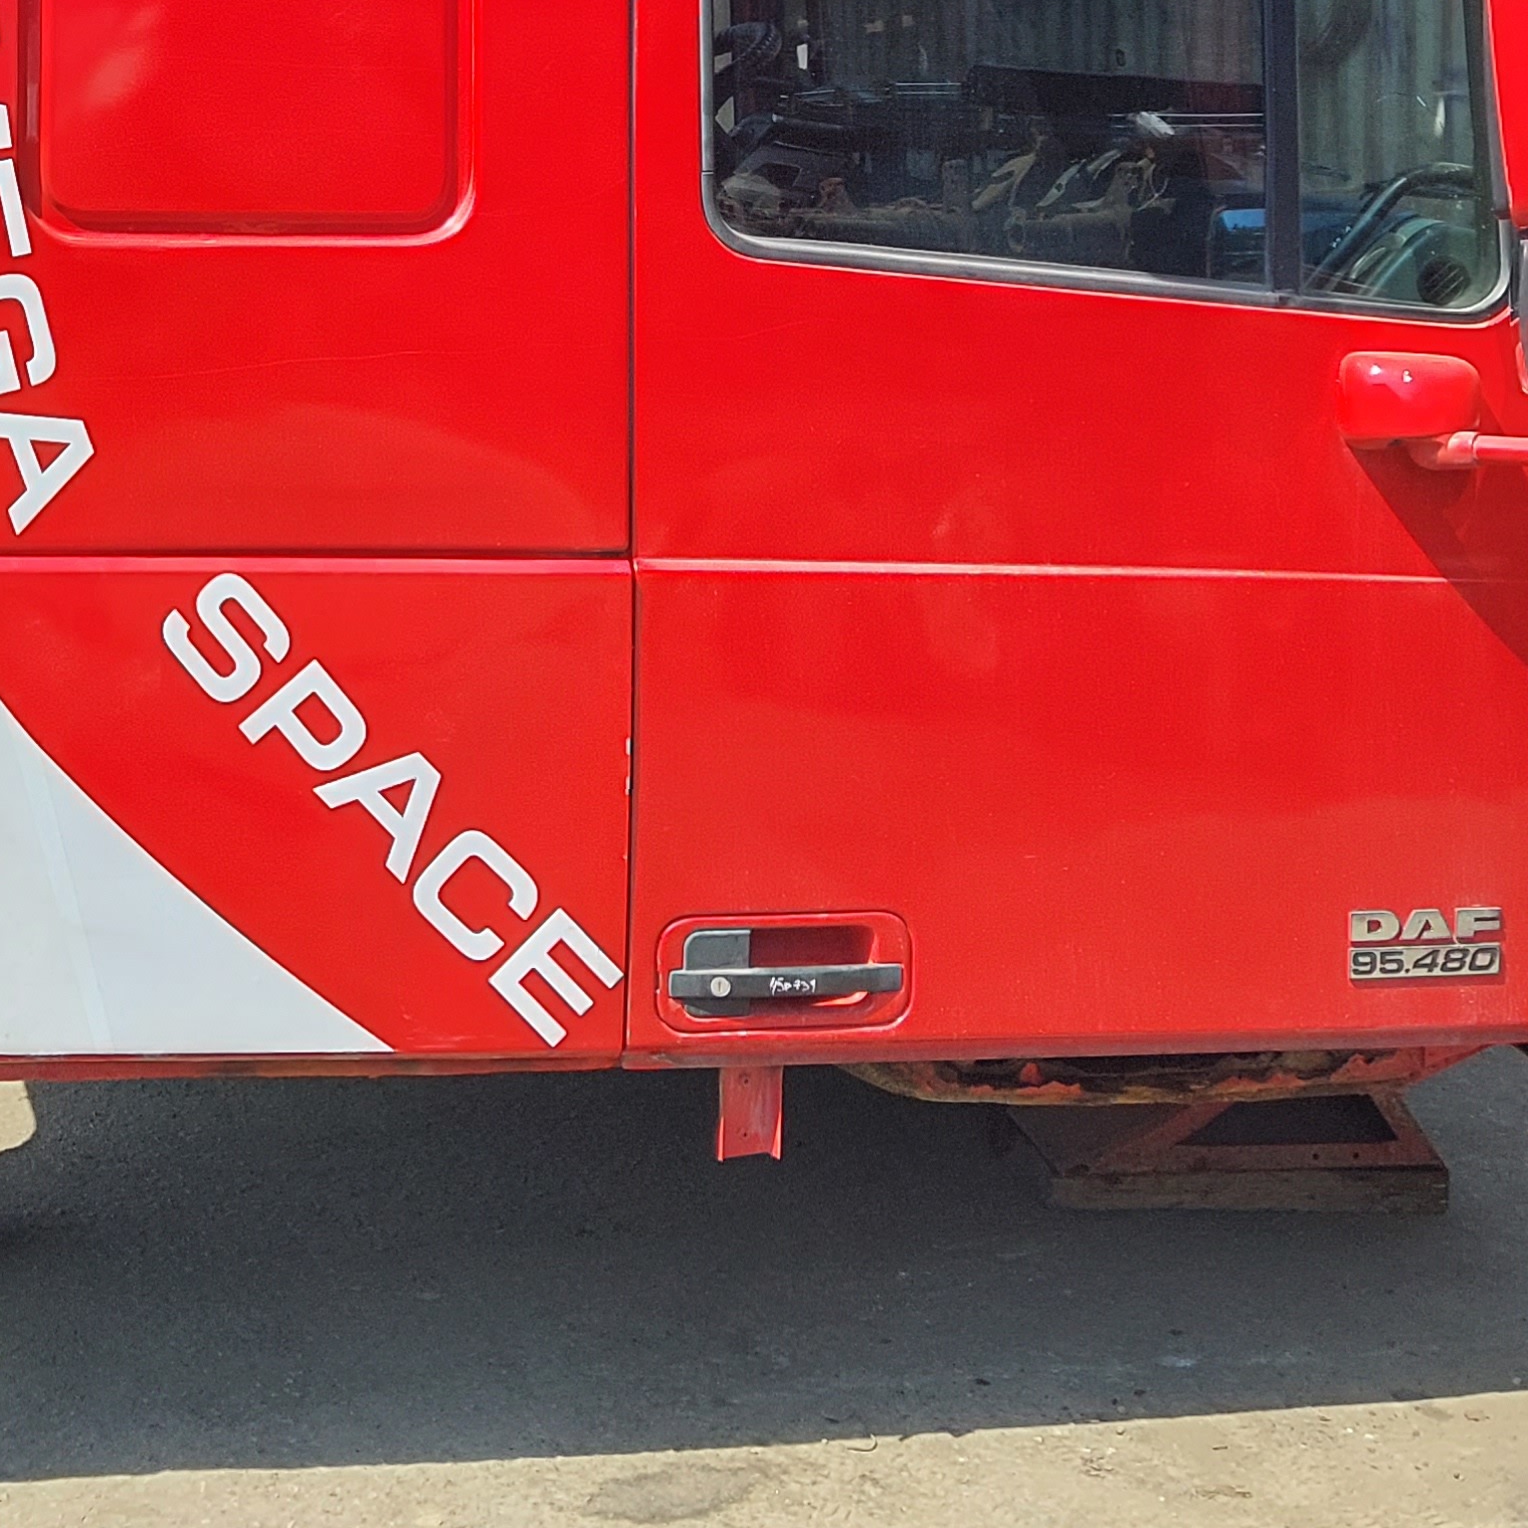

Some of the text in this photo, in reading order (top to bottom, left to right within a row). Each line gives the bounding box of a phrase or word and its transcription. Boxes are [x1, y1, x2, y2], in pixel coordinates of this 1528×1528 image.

[162, 572, 625, 1047] SPACE
[1349, 907, 1502, 941] DAF
[1351, 947, 1499, 976] 95.480
